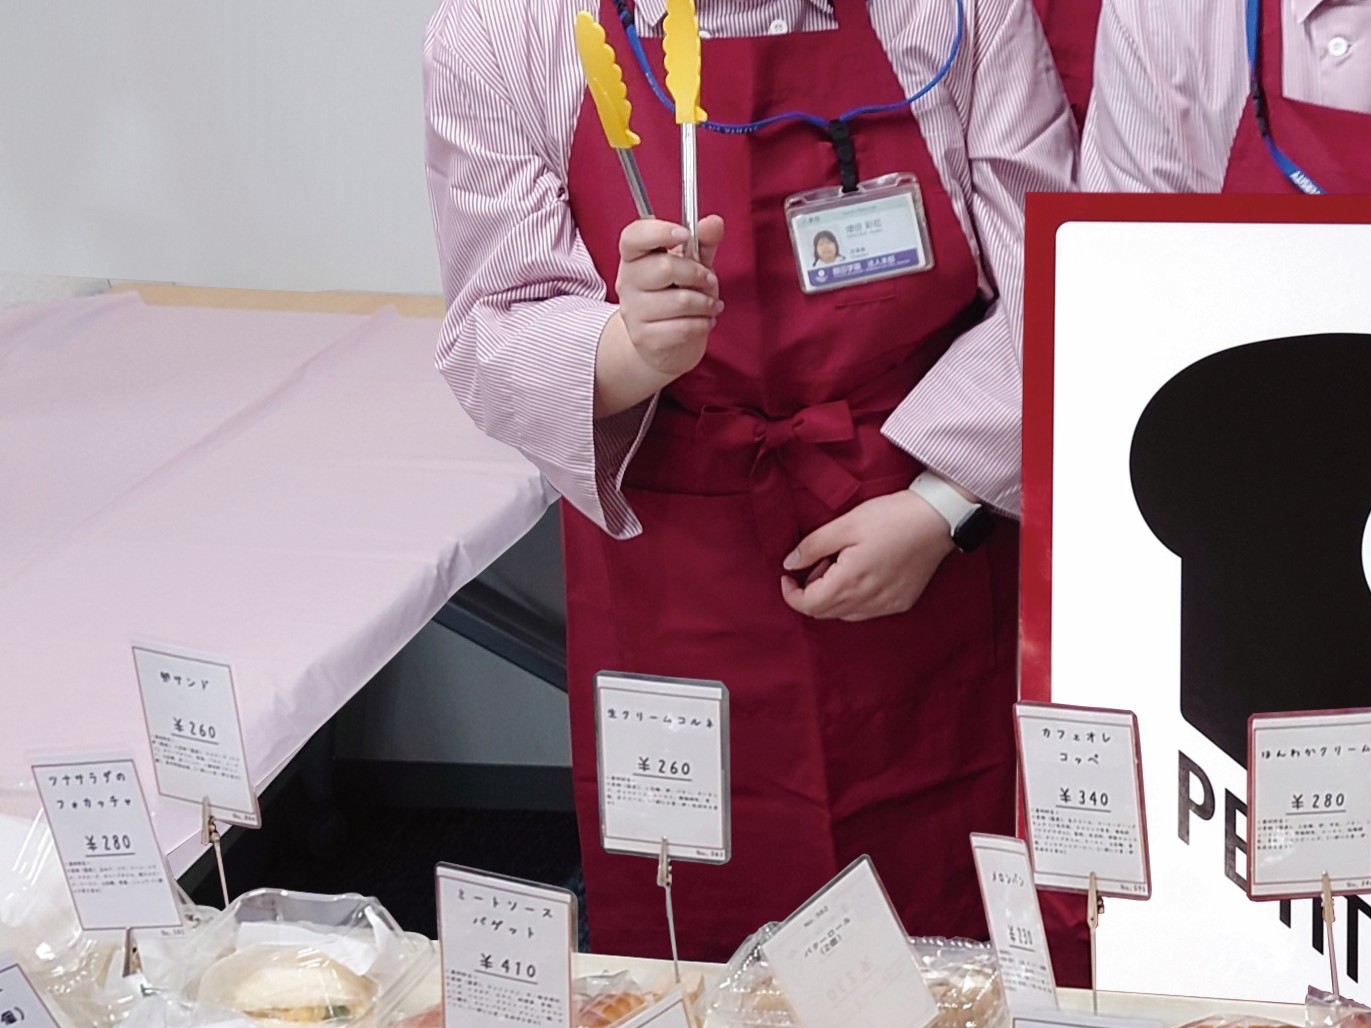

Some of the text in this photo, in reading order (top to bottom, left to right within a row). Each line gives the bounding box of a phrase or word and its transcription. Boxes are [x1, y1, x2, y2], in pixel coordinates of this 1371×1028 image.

[1042, 727, 1111, 743] カフェオレ
[1059, 752, 1100, 765] コッペ
[1261, 745, 1371, 760] ほんわかクリーム
[638, 756, 691, 776] ¥260
[48, 770, 126, 786] ツナサラダの
[56, 795, 131, 809] フォカッチャ
[1059, 786, 1110, 807] ¥340
[1291, 793, 1345, 811] ¥280
[85, 834, 131, 851] ¥280
[458, 889, 554, 918] ミートソース
[472, 916, 535, 939] バゲット
[803, 916, 852, 958] バターロール
[480, 952, 537, 978] ¥410
